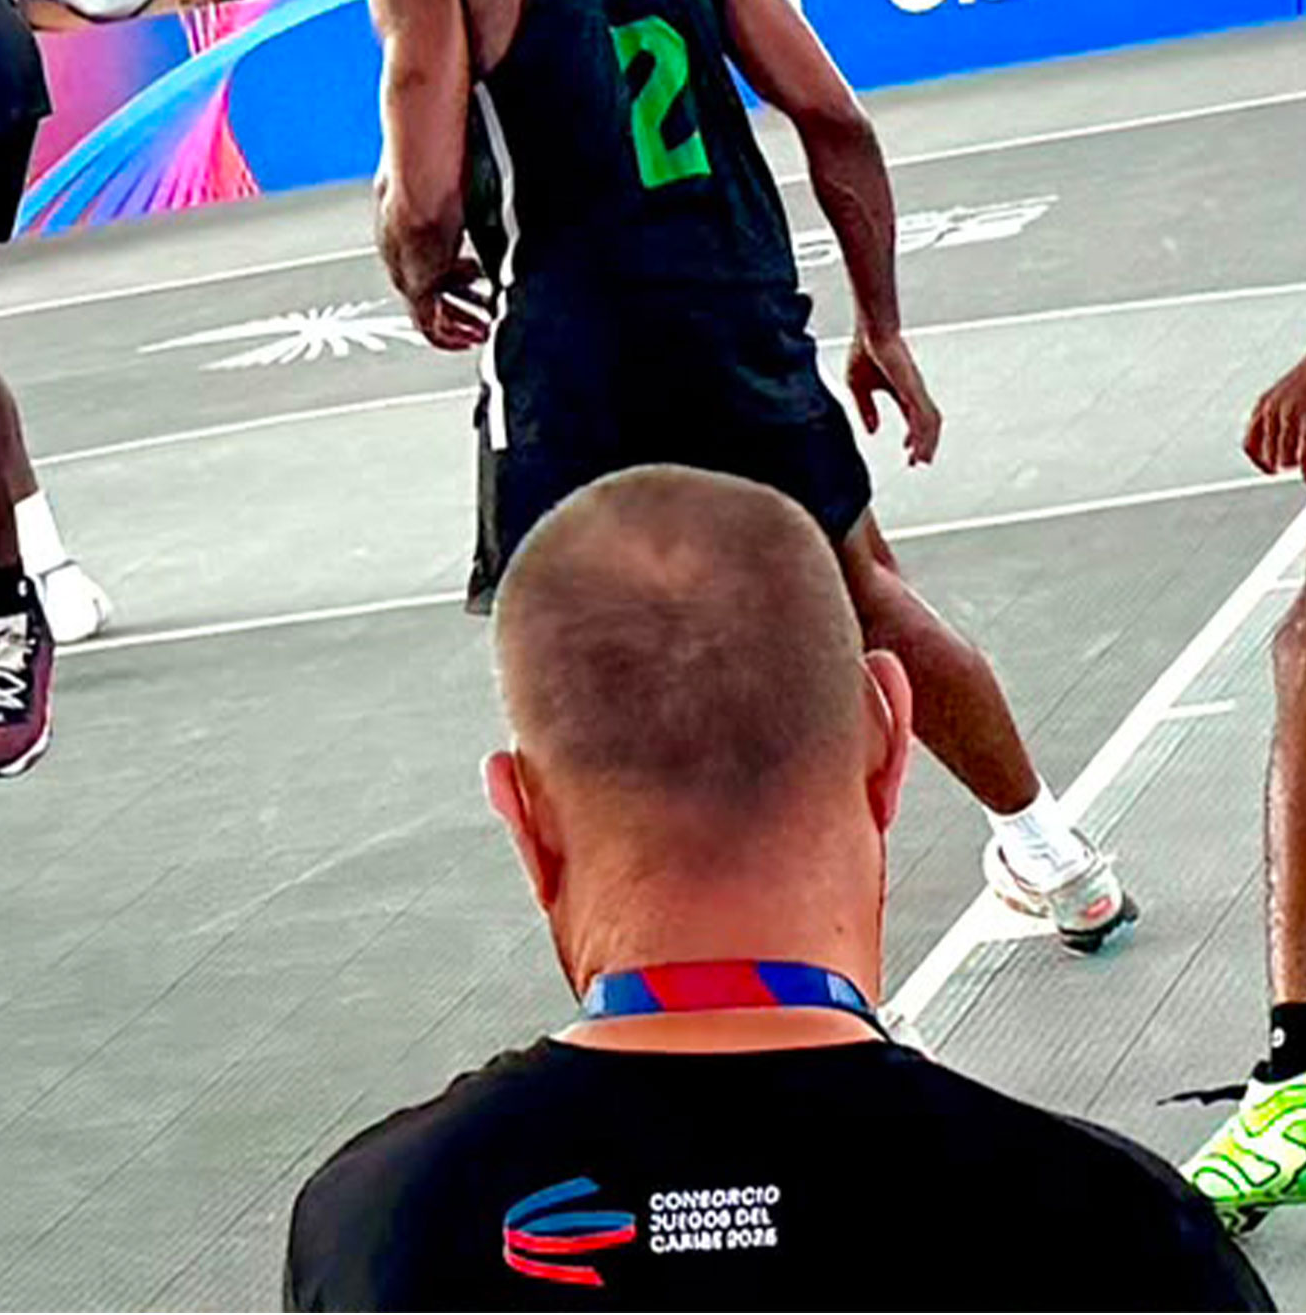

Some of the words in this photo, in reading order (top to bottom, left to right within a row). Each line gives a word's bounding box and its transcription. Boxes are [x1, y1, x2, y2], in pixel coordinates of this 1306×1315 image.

[609, 14, 712, 190] 2
[649, 1183, 781, 1212] CONSORCIO
[734, 1206, 773, 1227] DEL
